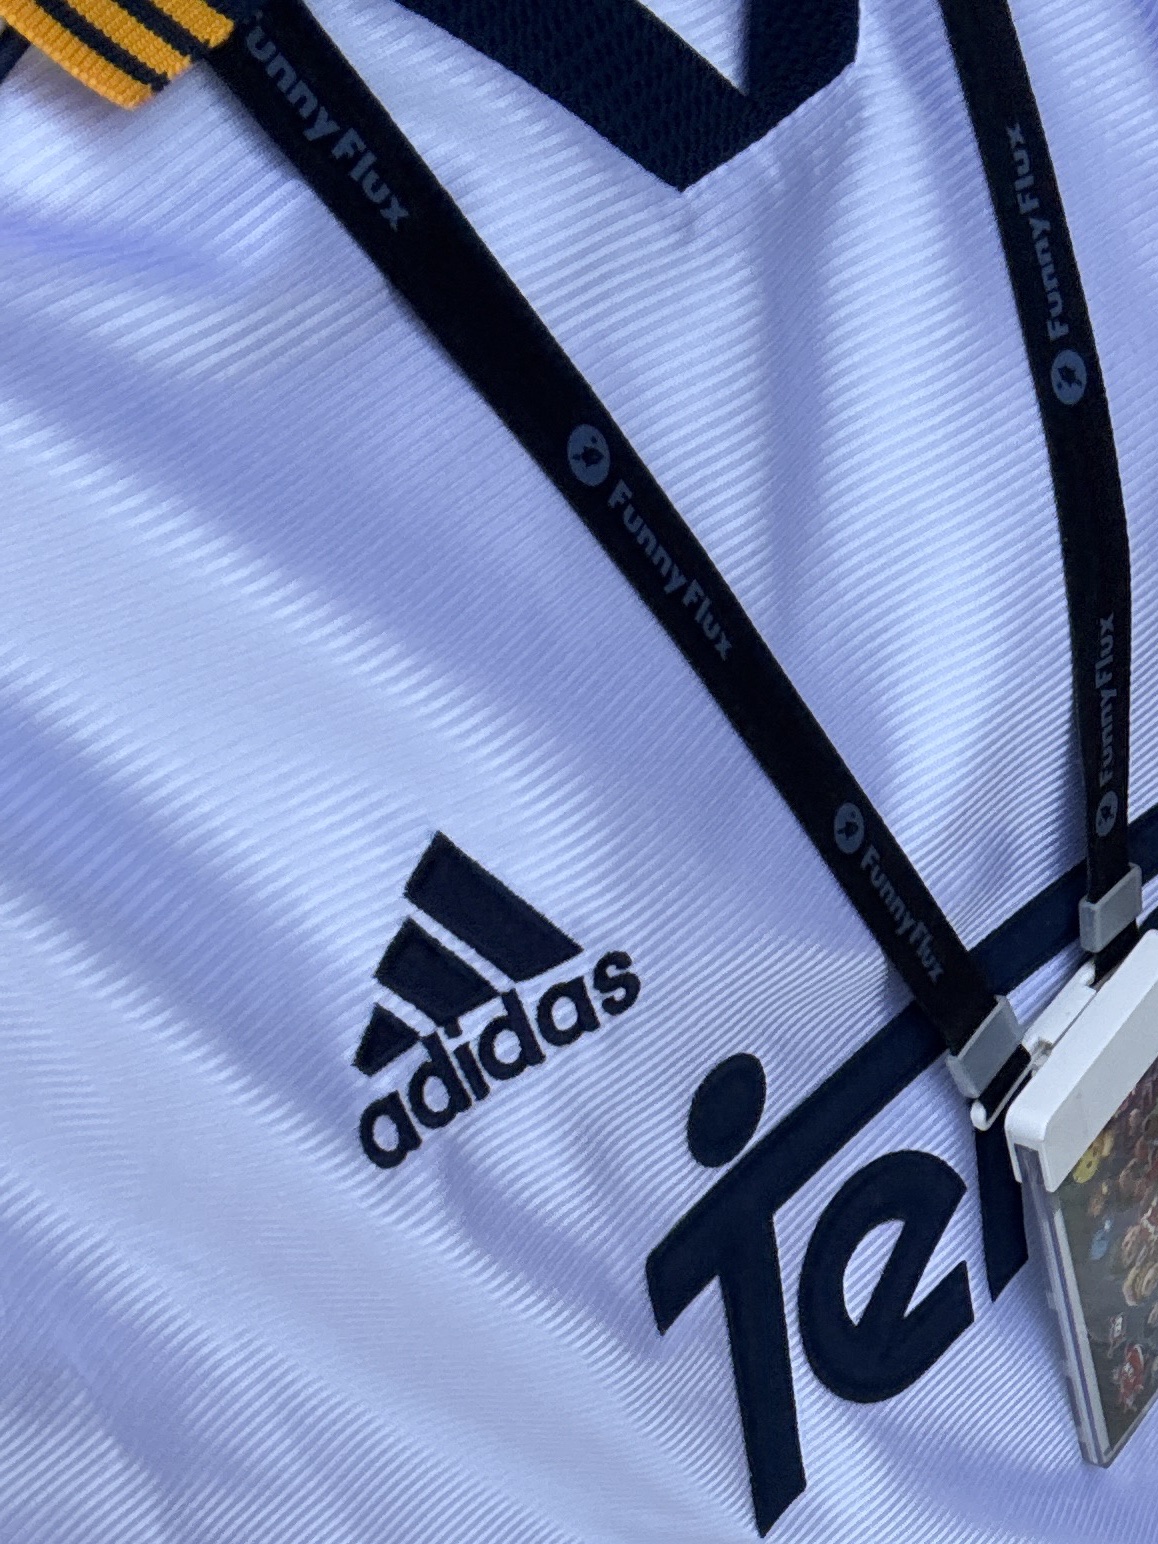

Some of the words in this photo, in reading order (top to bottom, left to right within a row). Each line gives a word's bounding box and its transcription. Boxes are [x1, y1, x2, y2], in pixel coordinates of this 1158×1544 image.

[246, 9, 409, 232] unnyFlux
[1006, 122, 1069, 341] FunnyFlux
[608, 479, 732, 661] FunnyFlux
[1095, 611, 1117, 788] FunnyFlux
[861, 844, 943, 985] FunnyFlux
[359, 951, 641, 1169] adidas
